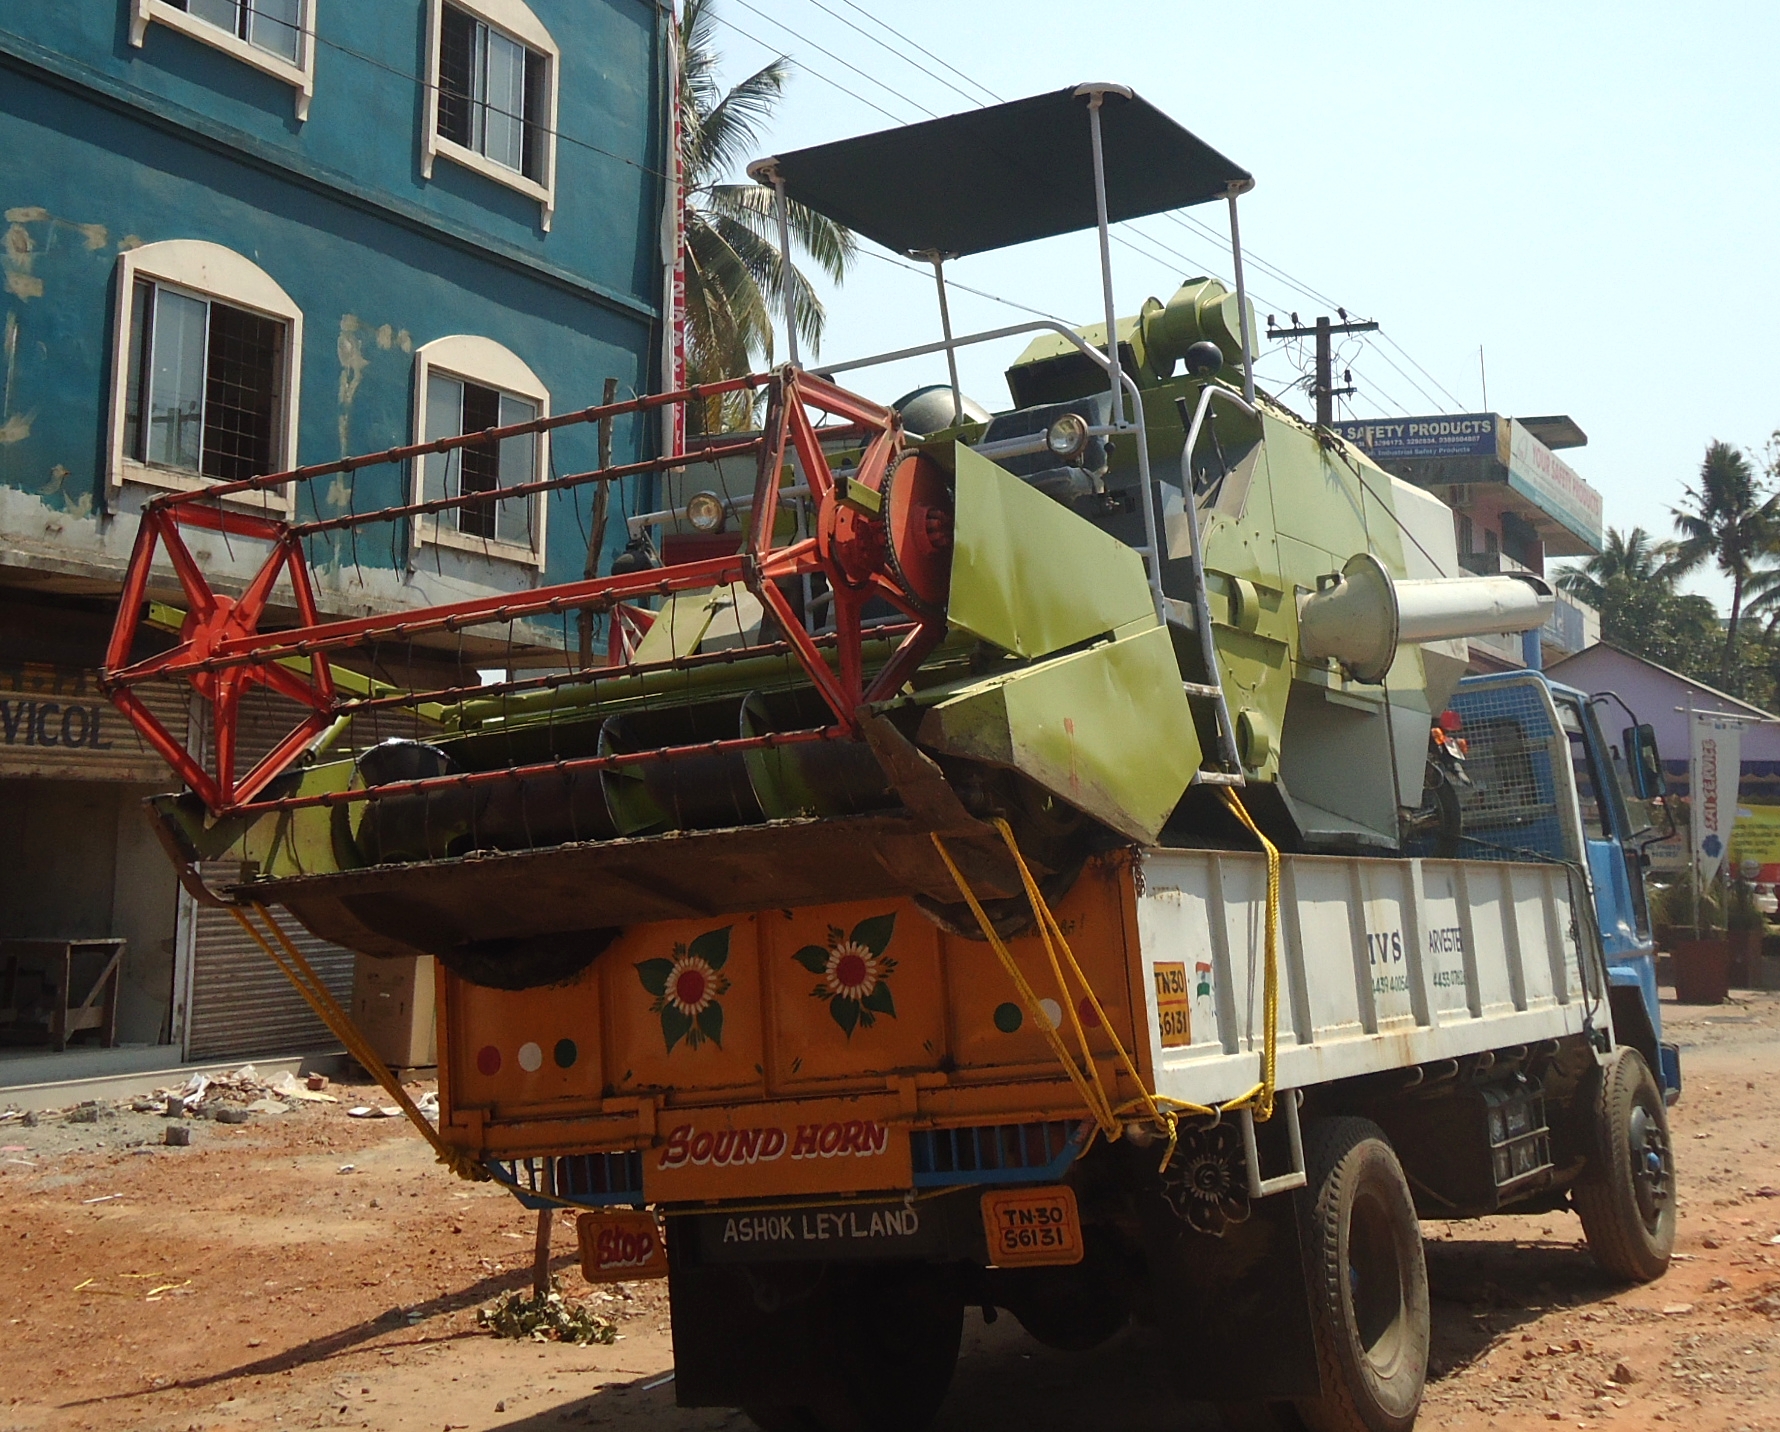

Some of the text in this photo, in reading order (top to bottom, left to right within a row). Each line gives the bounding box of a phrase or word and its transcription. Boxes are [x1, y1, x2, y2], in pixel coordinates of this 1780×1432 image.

[1347, 424, 1405, 440] SAFETY
[1409, 420, 1492, 437] PRODUCTS
[1414, 447, 1437, 456] Safety
[1438, 445, 1471, 454] Products
[0, 699, 113, 750] VICOL
[1701, 738, 1718, 832] SAI SERVICE
[657, 1120, 889, 1171] SOUND HORN
[724, 1209, 919, 1243] ASHOK LEYLAND
